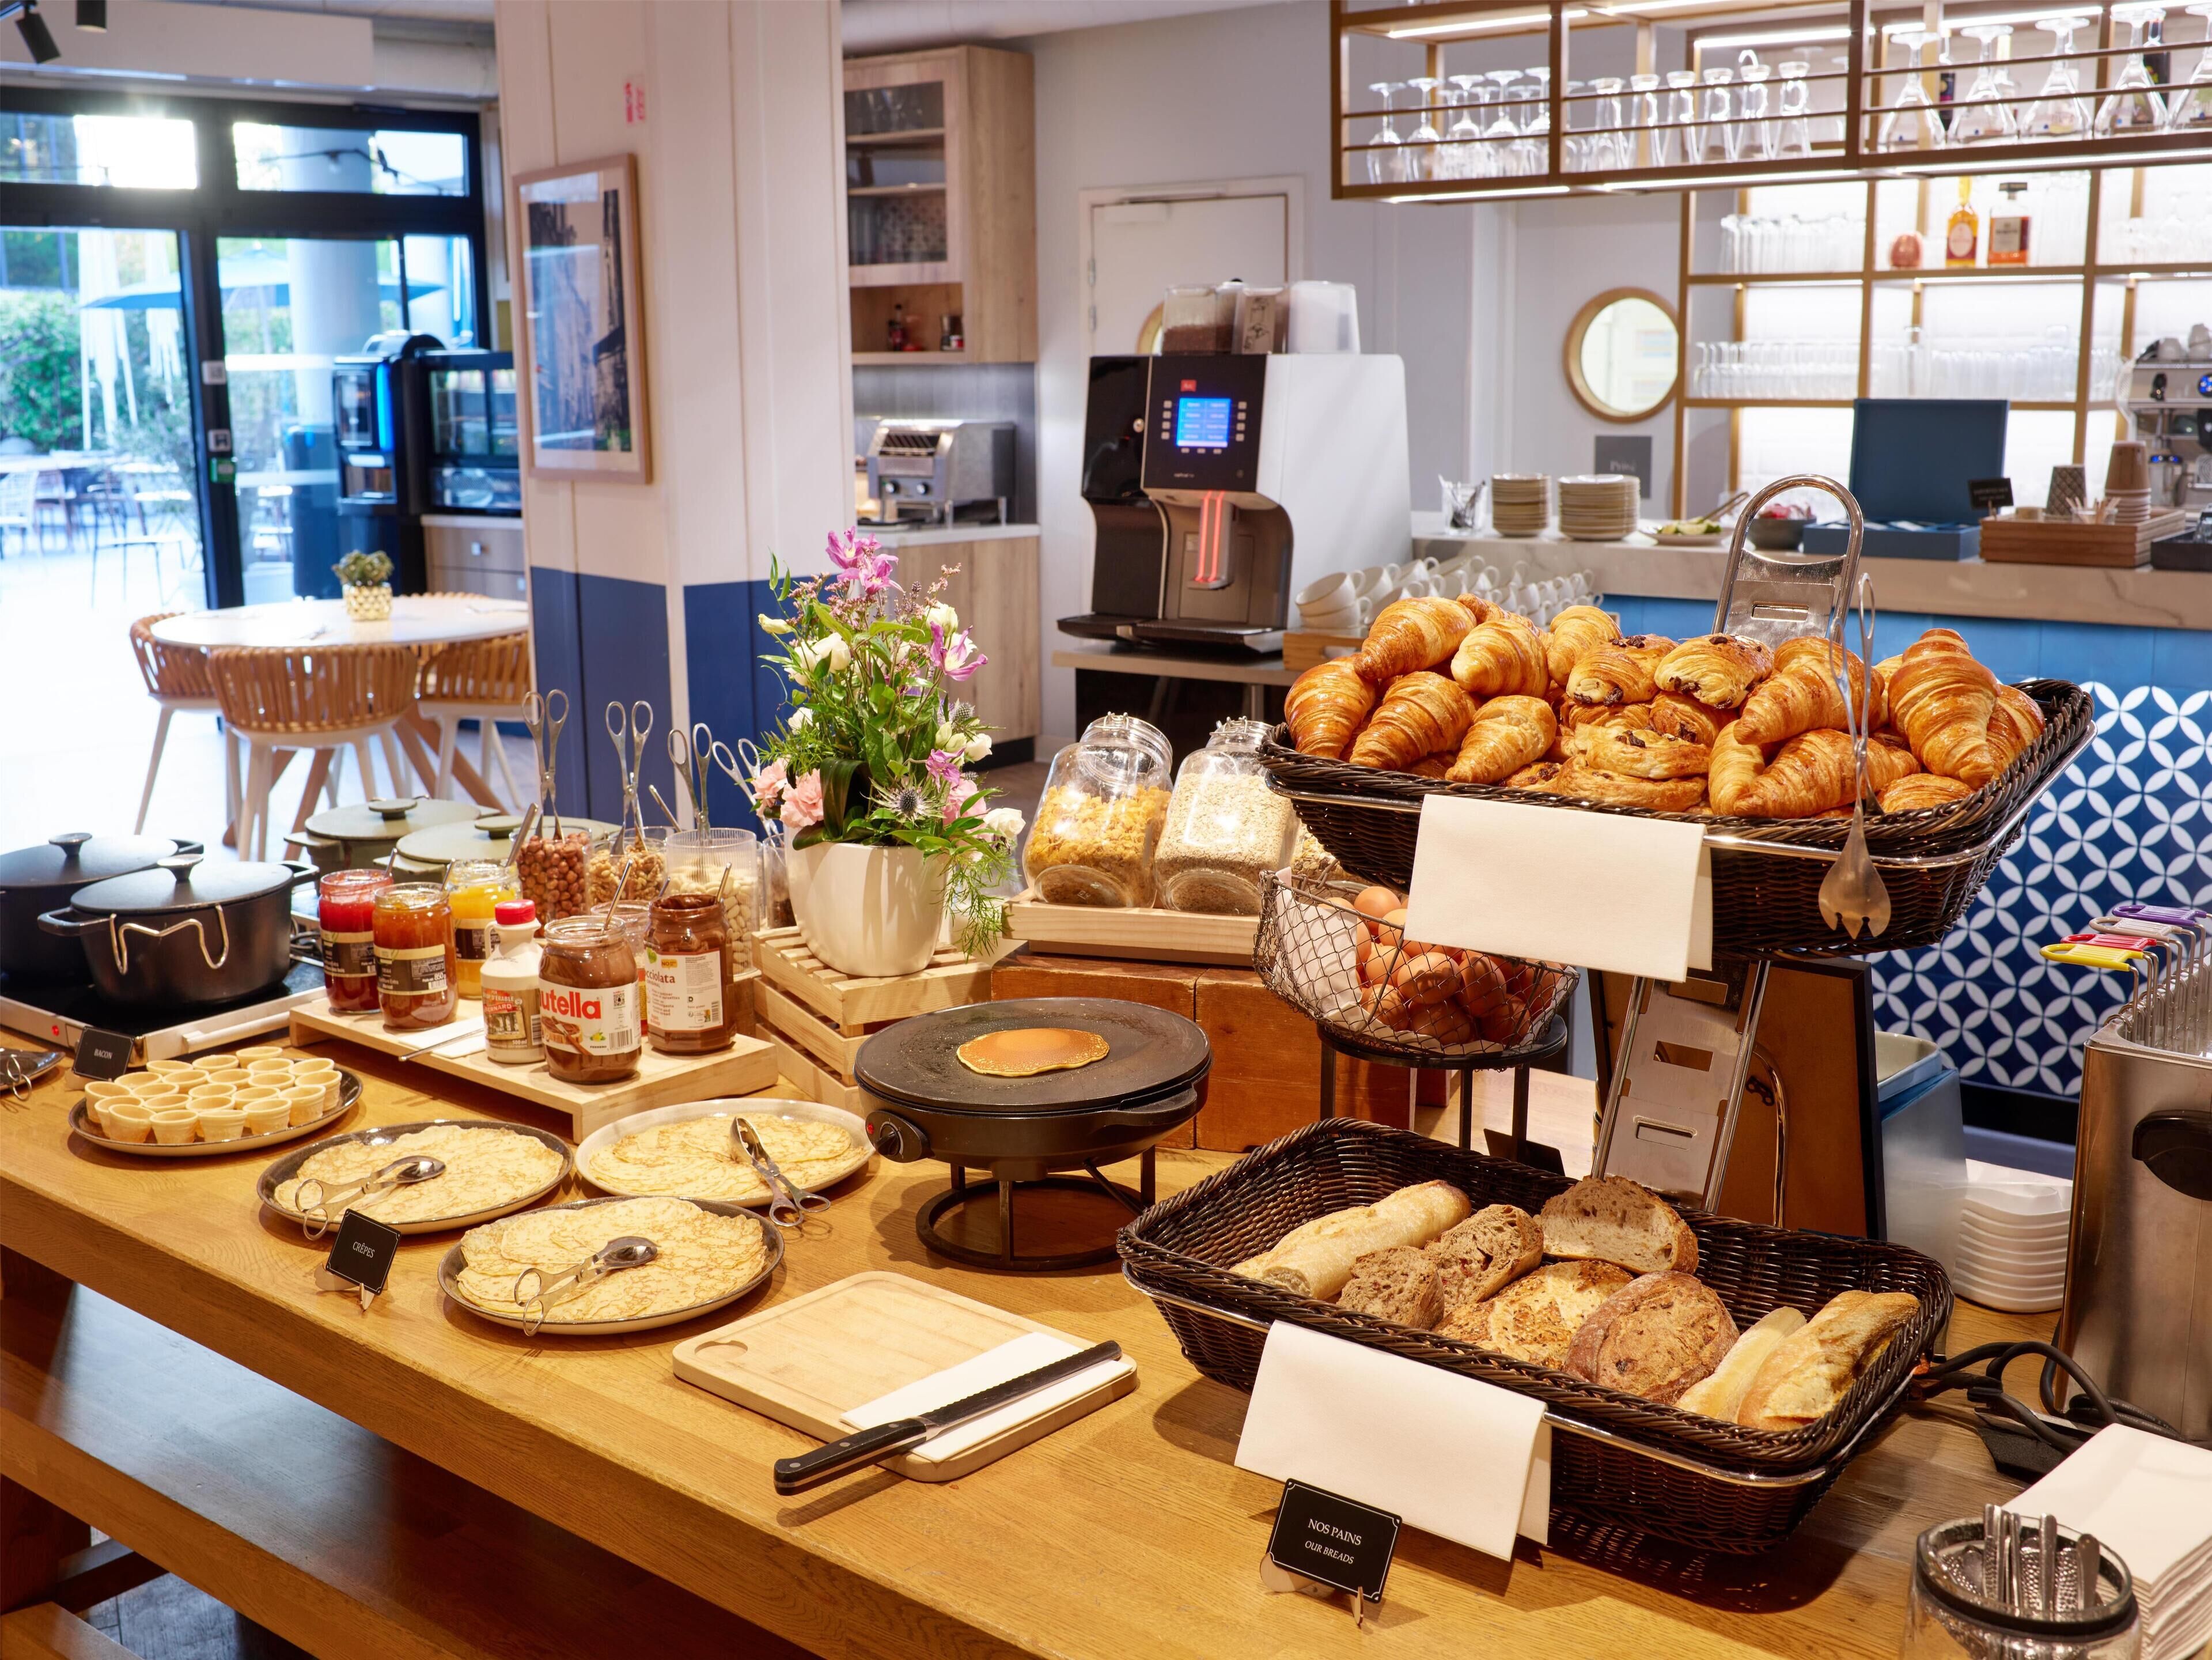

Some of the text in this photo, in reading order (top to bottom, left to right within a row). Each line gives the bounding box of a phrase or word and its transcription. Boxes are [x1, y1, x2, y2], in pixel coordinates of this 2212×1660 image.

[484, 1003, 512, 1012] BERNARD
[540, 989, 601, 1019] utella
[94, 1049, 113, 1060] BACON
[353, 1241, 375, 1258] CRÊPES
[1308, 1518, 1362, 1546] NOS PAINS
[1305, 1540, 1355, 1565] OUR BREADS
